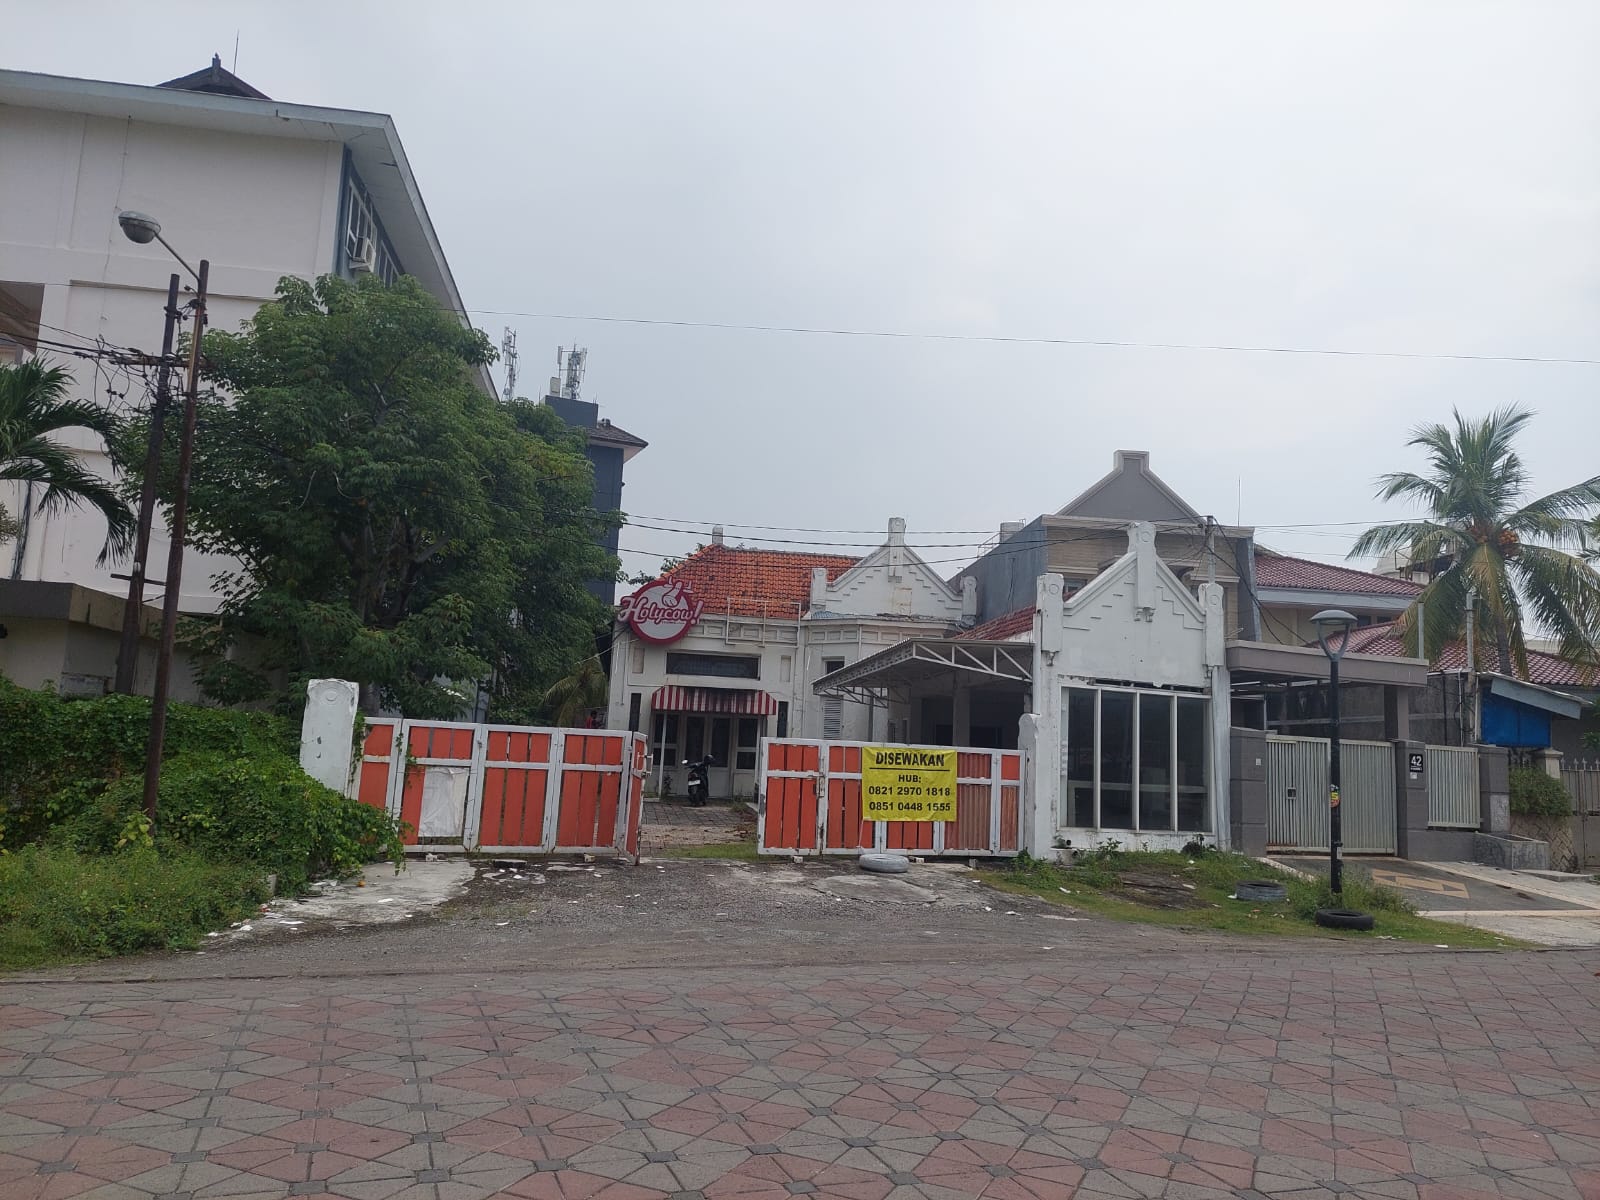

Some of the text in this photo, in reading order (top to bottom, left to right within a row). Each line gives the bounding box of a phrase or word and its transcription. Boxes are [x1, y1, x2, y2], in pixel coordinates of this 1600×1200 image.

[618, 596, 704, 625] Holycow!
[876, 752, 944, 766] DISEWAKAN
[1411, 755, 1422, 766] 42
[898, 774, 922, 783] HUB:
[868, 786, 950, 796] 0821 2970 1818
[869, 801, 951, 811] 0851 0448 1555
